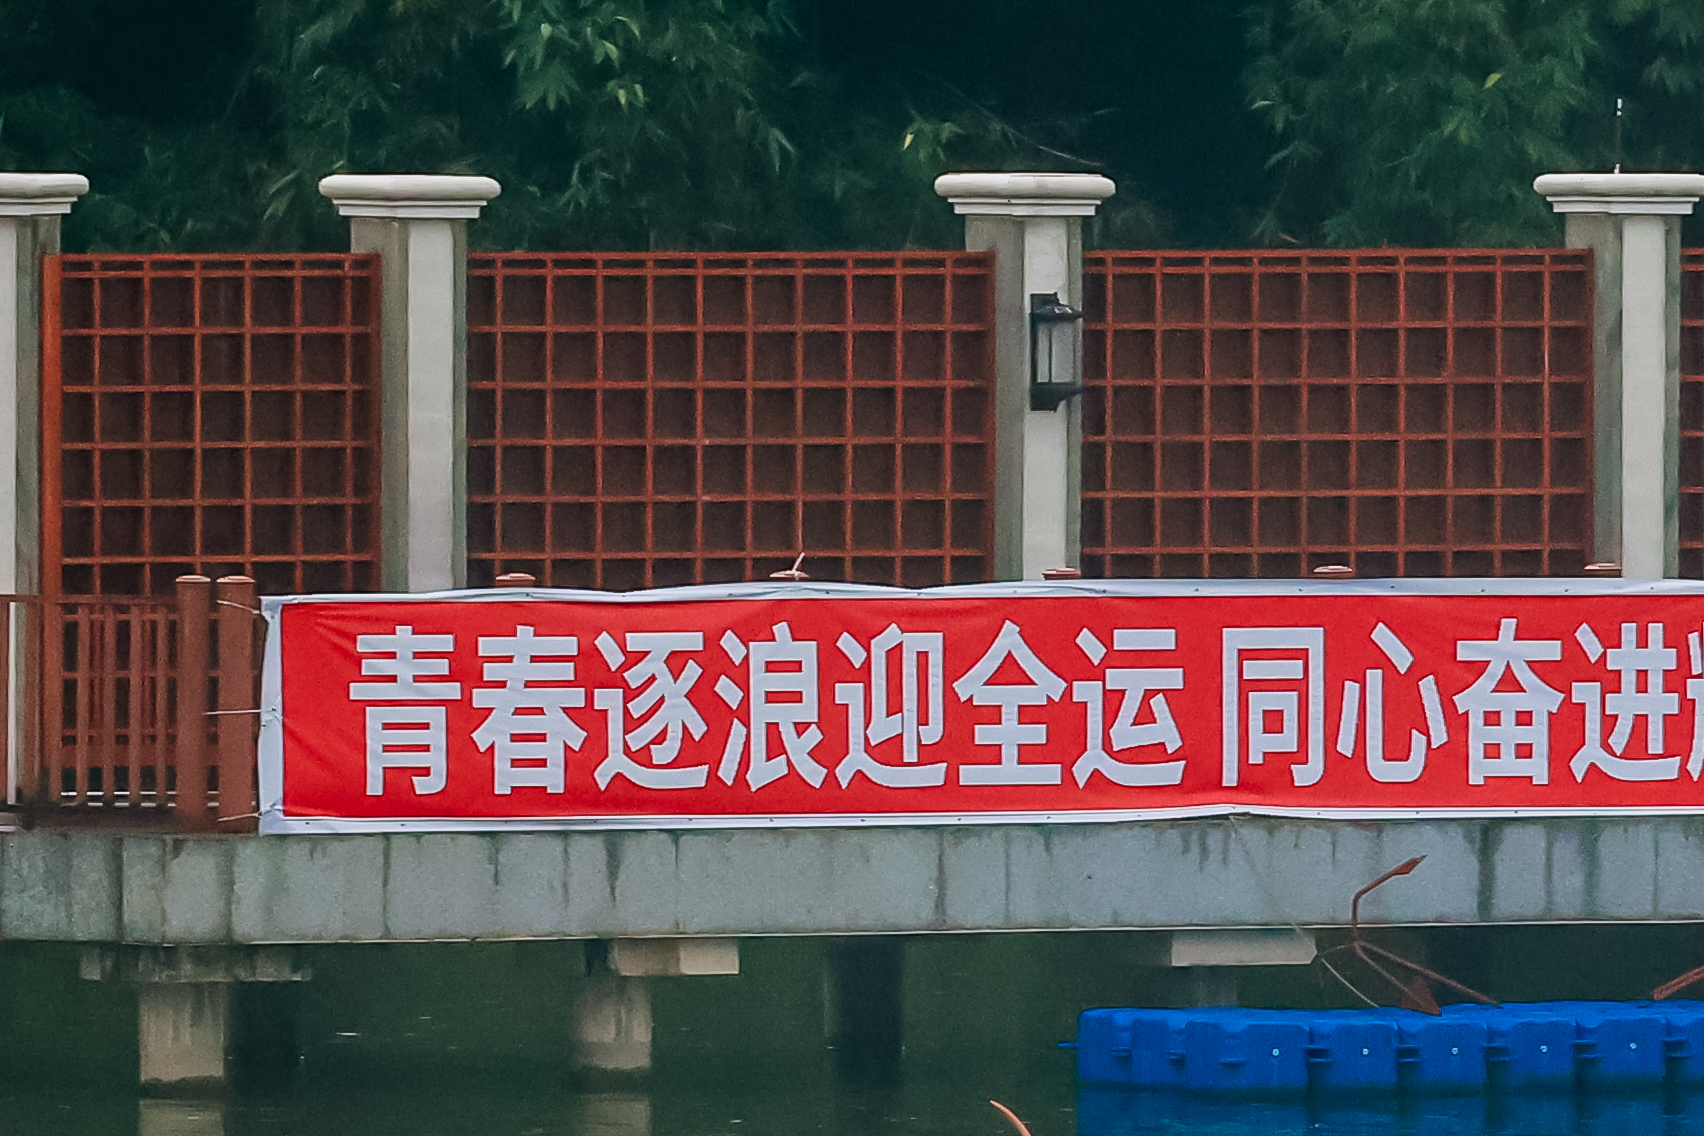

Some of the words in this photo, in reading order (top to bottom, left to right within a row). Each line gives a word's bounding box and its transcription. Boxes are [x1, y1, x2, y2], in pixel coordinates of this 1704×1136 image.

[349, 619, 1187, 796] 青春逐浪迎全运
